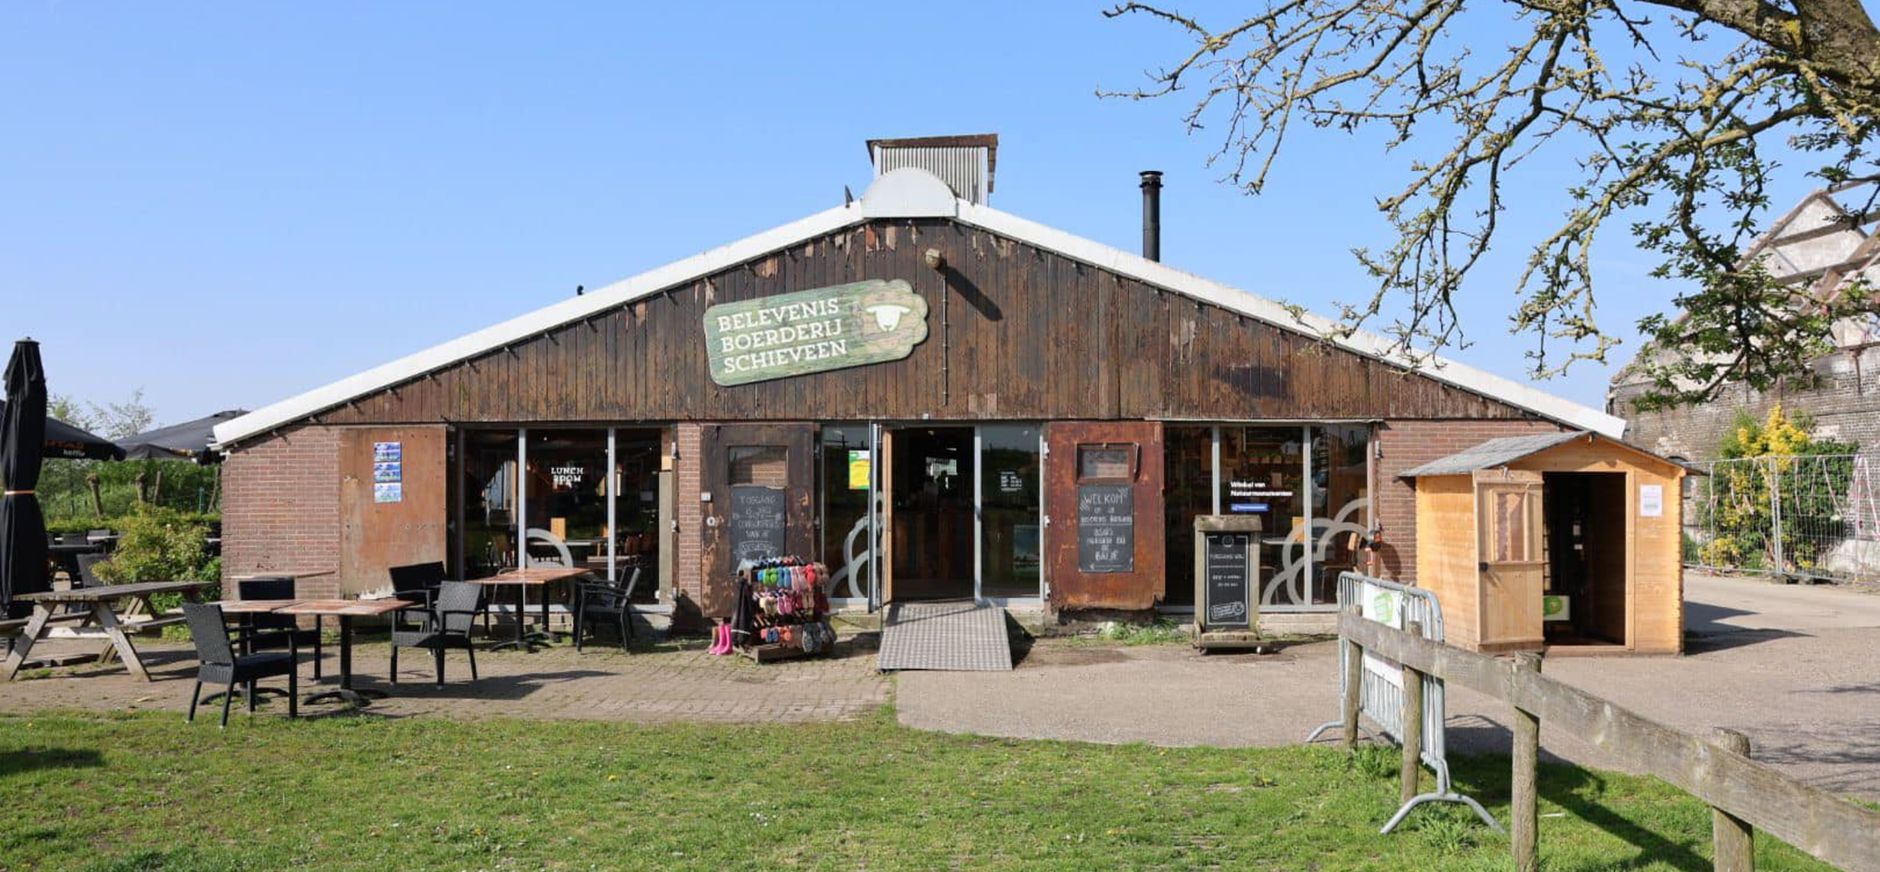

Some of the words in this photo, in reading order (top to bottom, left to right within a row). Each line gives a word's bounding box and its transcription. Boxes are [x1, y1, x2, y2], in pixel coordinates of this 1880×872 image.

[717, 298, 839, 333] BELEVENIS
[721, 318, 842, 353] BOERDERIJ
[724, 339, 847, 374] SCHIEVEEN
[551, 467, 584, 475] LUNCH
[1230, 480, 1254, 488] Winkel
[1083, 493, 1123, 505] WELKOM
